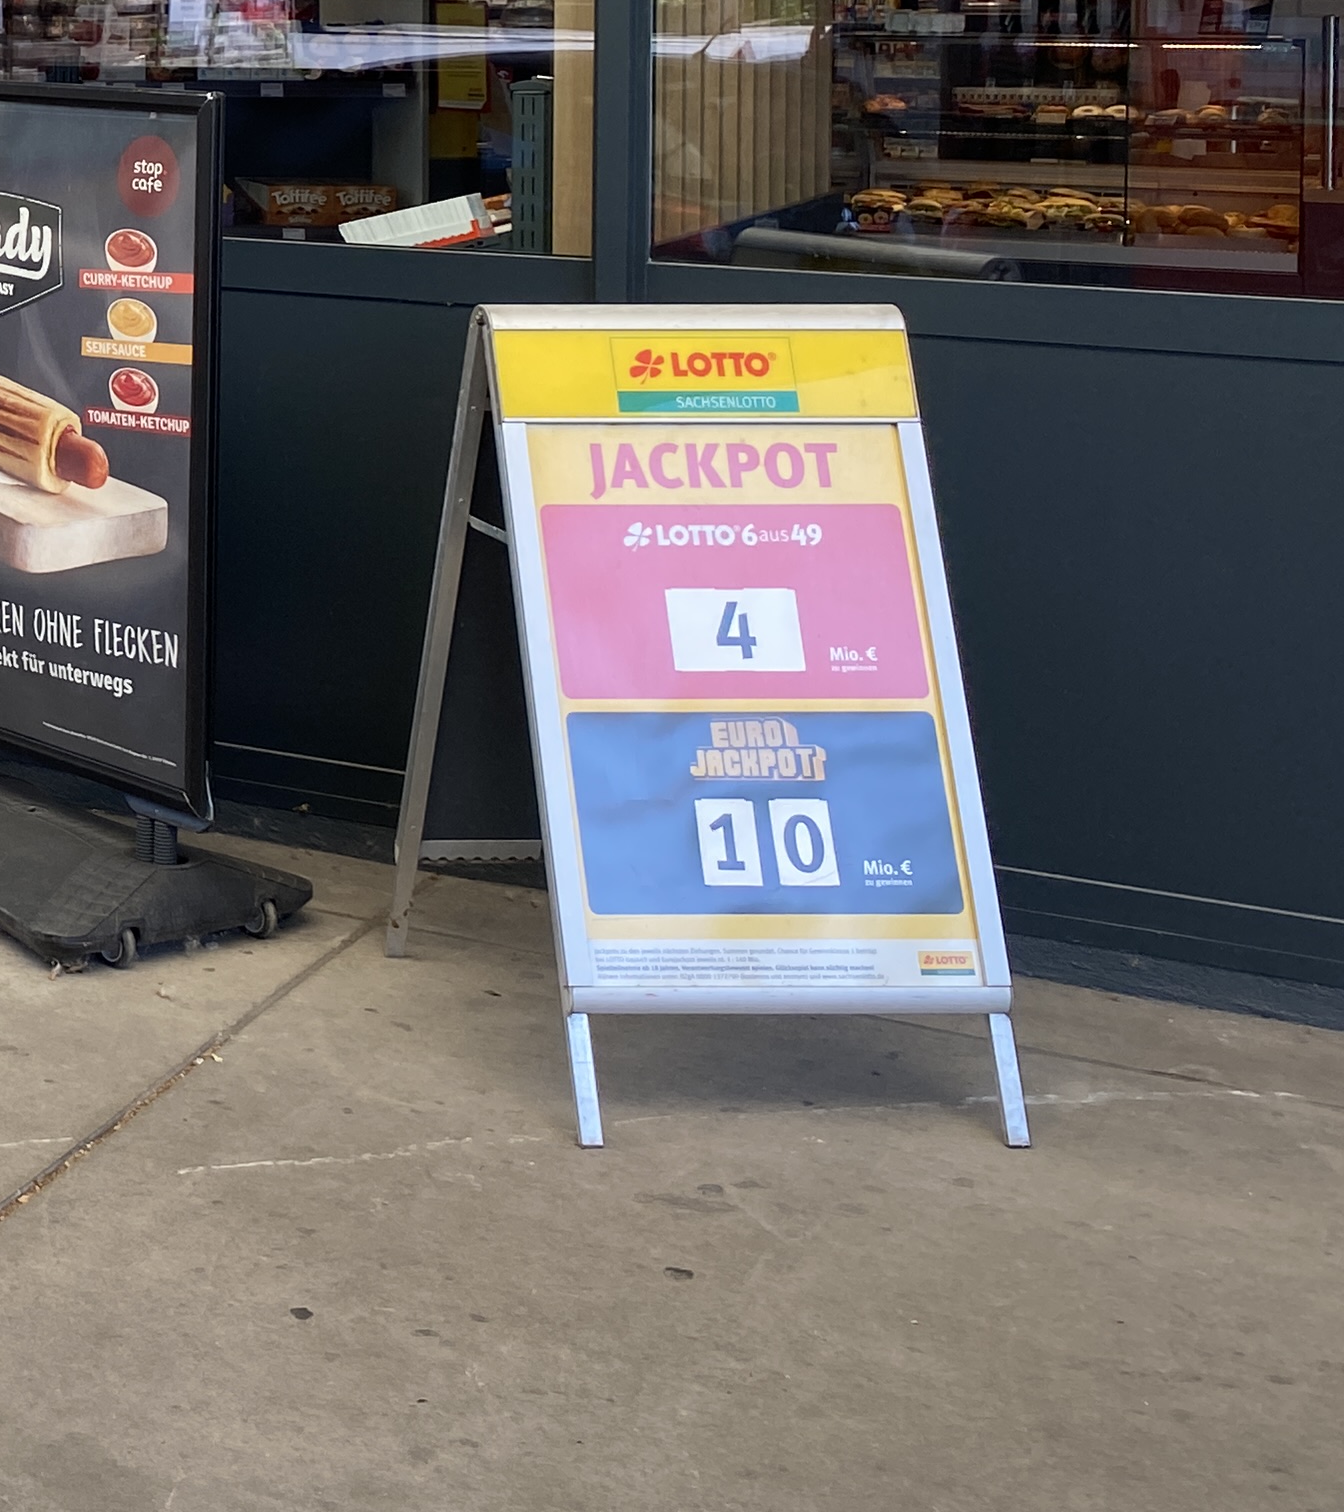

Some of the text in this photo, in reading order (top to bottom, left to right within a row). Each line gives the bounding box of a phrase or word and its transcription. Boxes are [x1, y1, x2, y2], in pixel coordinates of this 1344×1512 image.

[133, 159, 163, 176] stop
[131, 175, 163, 192] cafe
[272, 189, 327, 206] Toffifee
[336, 190, 392, 206] Toffifee
[82, 272, 173, 289] CURRY-KETCHUP
[85, 340, 146, 358] SENFSAUCE
[670, 352, 770, 377] LOTTO
[675, 396, 776, 409] SACHSENLOTTO
[87, 409, 190, 433] TOMATEN-KETCHUP
[589, 442, 838, 500] JACKPOT
[655, 524, 736, 546] LOTTO
[33, 608, 83, 648] OHNE
[94, 618, 179, 668] FLECKEN
[715, 600, 758, 660] 4
[829, 646, 878, 661] Mio. €
[21, 650, 45, 675] für
[48, 660, 134, 698] unterwegs
[710, 719, 786, 748] EURO
[690, 748, 818, 779] JACKPOT
[863, 860, 913, 875] Mio. €
[875, 878, 913, 887] gewinnen
[936, 955, 966, 965] LOTTO
